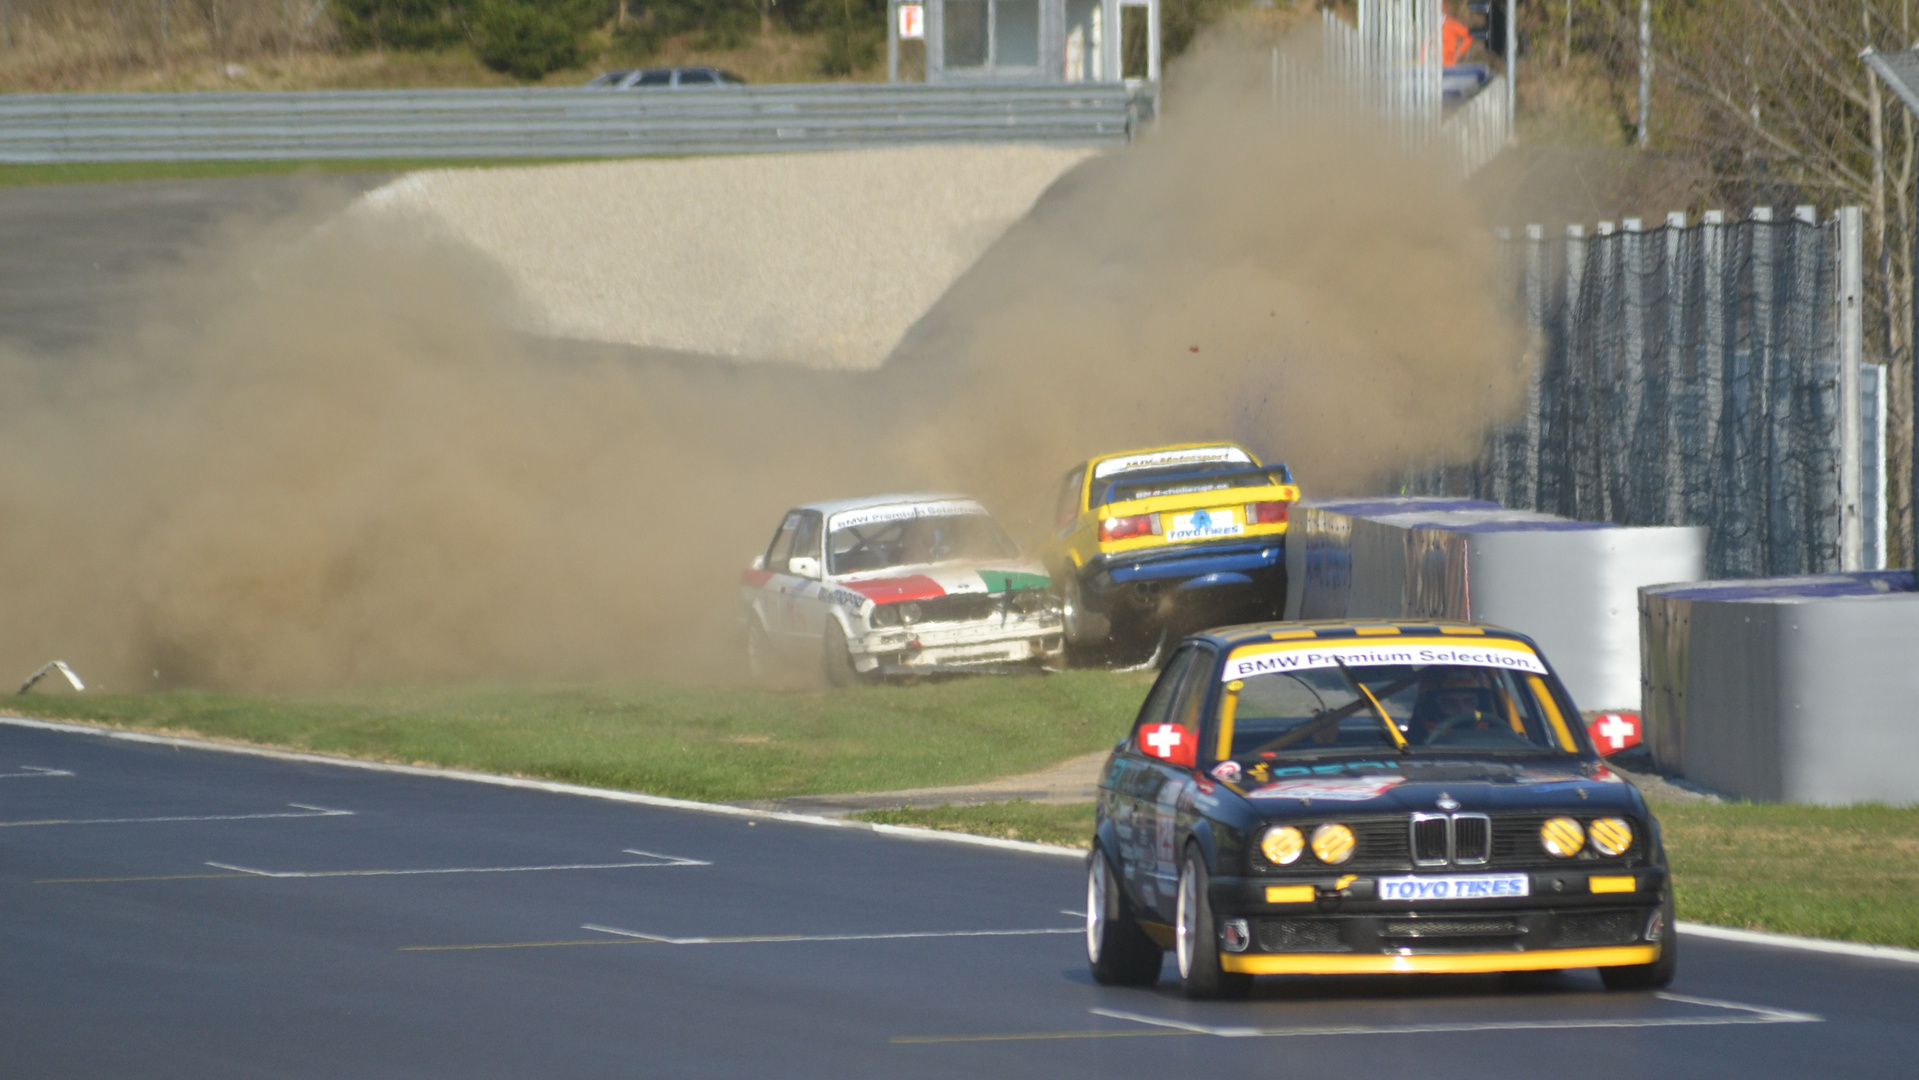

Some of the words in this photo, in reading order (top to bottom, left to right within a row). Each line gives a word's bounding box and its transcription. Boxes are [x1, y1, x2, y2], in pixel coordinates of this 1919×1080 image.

[837, 515, 869, 527] BMW
[1170, 529, 1201, 539] TOYO
[1204, 525, 1239, 536] TIRES
[1238, 655, 1299, 675] BMW
[1307, 651, 1411, 665] Premium
[1419, 650, 1537, 669] Selection.
[1385, 880, 1450, 898] TOYO
[1454, 879, 1525, 897] TIRES
